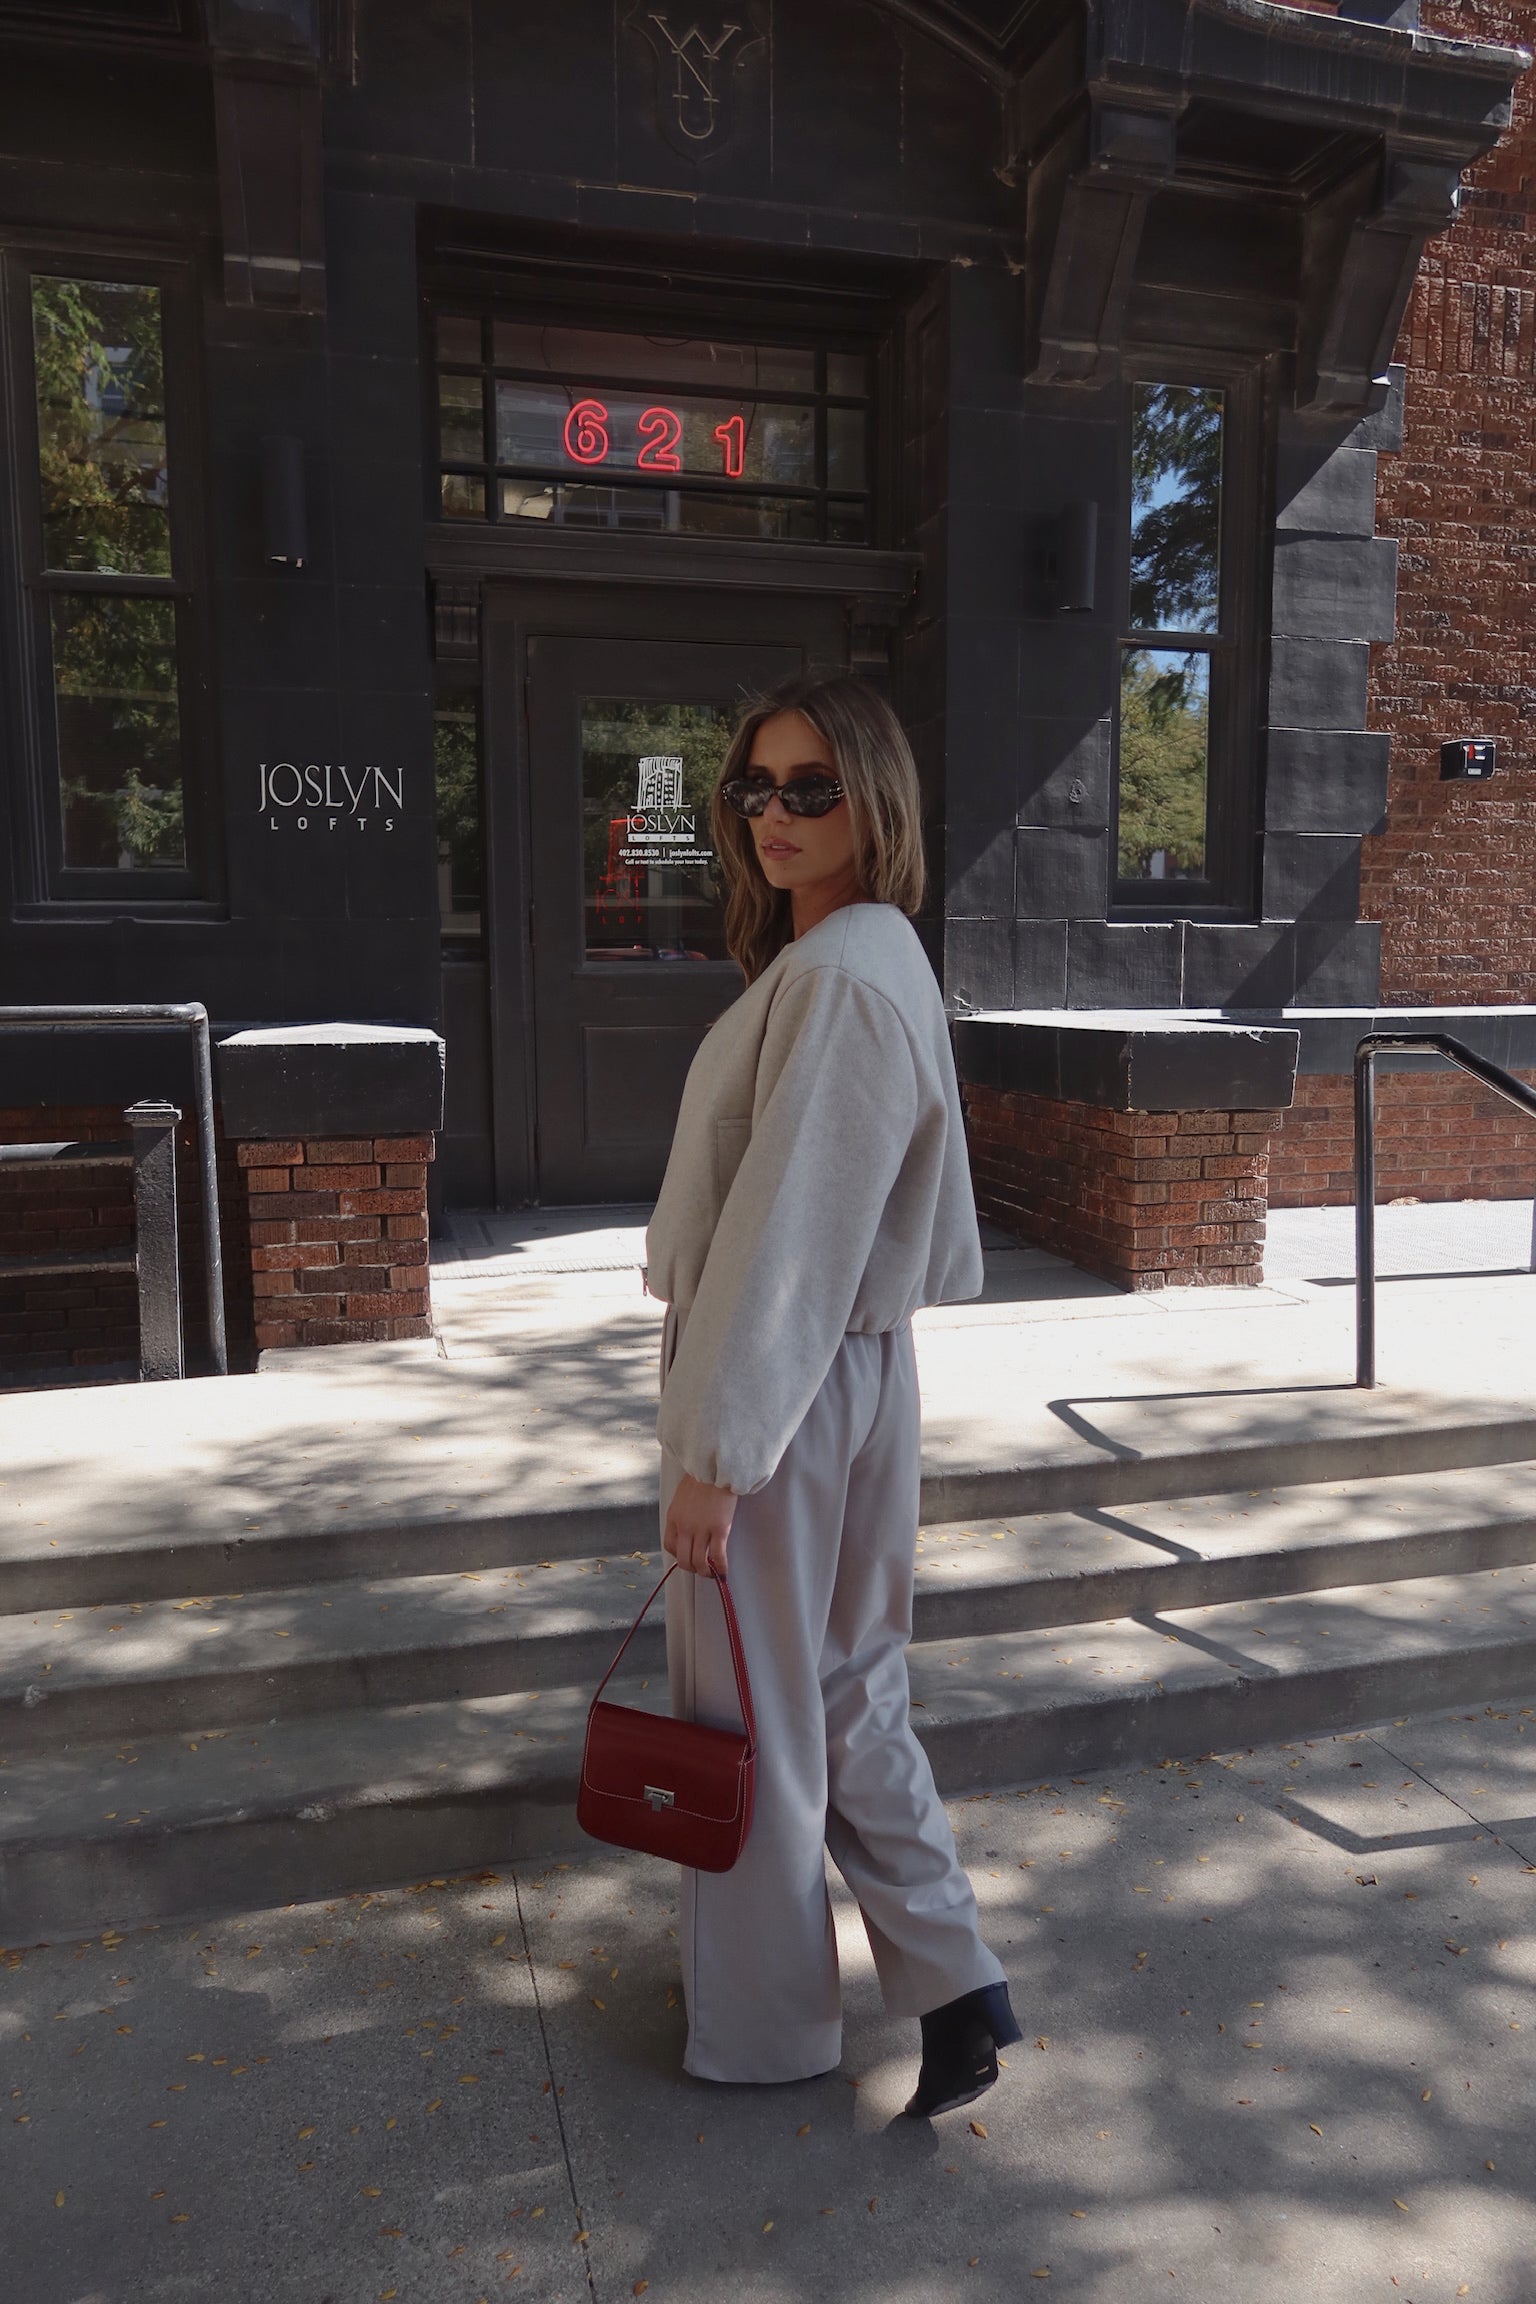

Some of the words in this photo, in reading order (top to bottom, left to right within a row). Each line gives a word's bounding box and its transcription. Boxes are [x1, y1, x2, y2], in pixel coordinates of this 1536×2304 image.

[258, 762, 404, 815] JOSLYN
[270, 816, 395, 831] LOFTS
[626, 813, 696, 833] JOSLYN
[669, 848, 713, 858] joslynlofts.com
